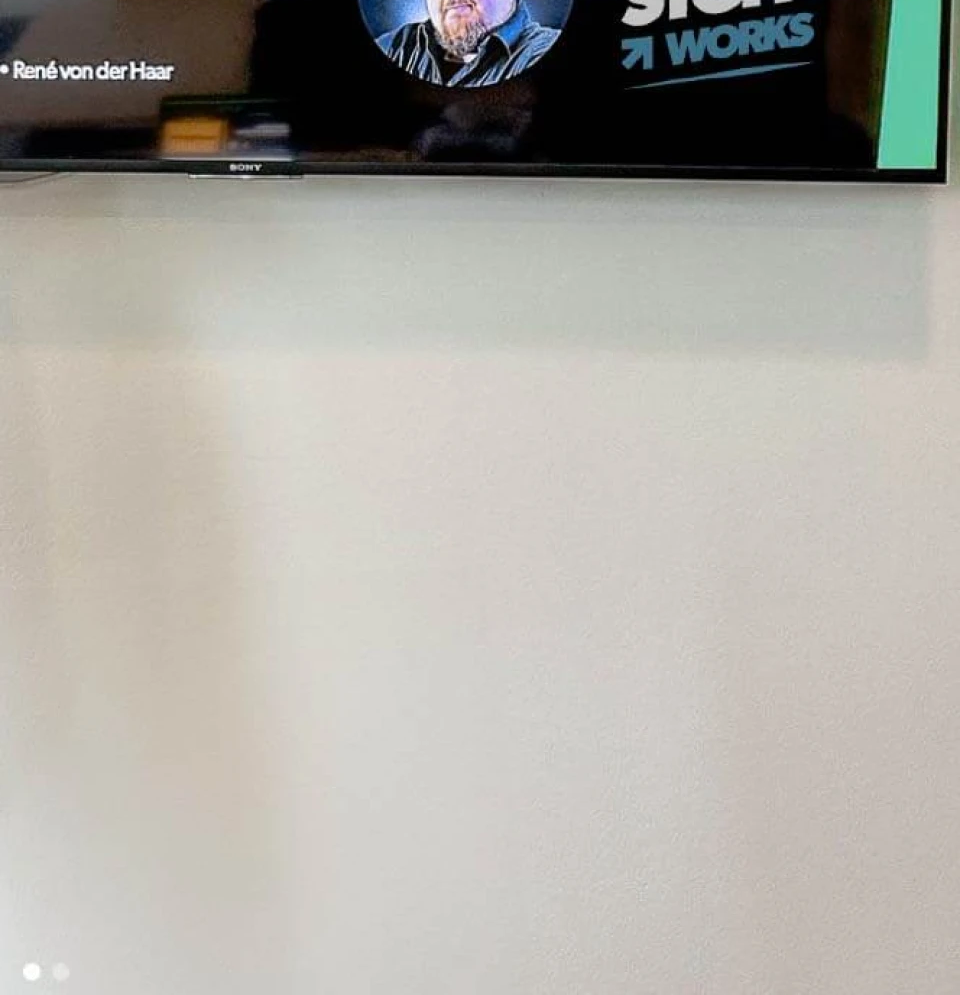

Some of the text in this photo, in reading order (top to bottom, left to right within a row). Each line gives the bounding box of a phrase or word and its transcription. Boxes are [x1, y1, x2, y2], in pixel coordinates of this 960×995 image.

[665, 12, 815, 66] WORKS
[12, 59, 58, 80] René
[58, 65, 94, 80] von
[97, 60, 128, 80] der
[129, 61, 175, 80] Haar
[229, 163, 262, 172] SONY
